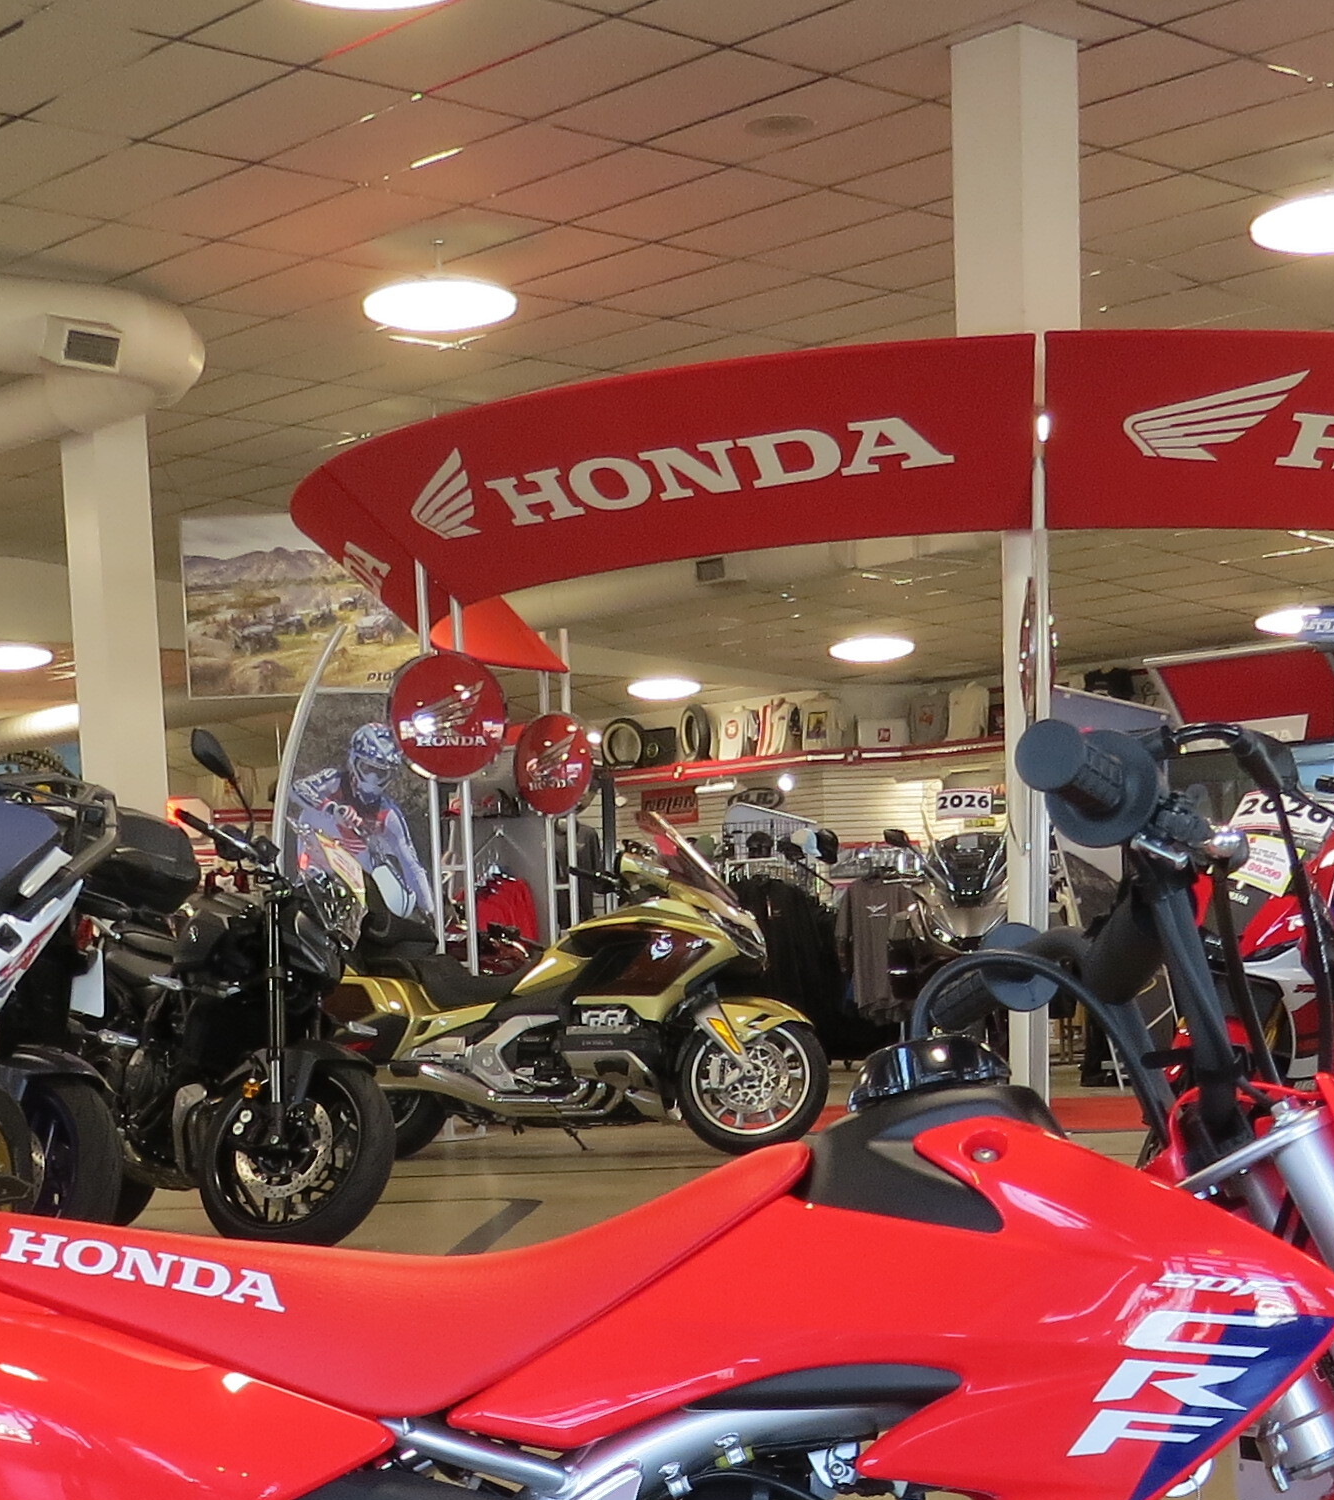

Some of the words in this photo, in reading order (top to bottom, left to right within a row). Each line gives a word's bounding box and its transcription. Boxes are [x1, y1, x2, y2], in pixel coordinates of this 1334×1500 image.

[485, 416, 955, 527] HONDA
[416, 735, 488, 748] HONDA
[938, 794, 990, 811] 2026
[0, 1227, 285, 1314] HONDA
[1066, 1310, 1299, 1457] CRF
